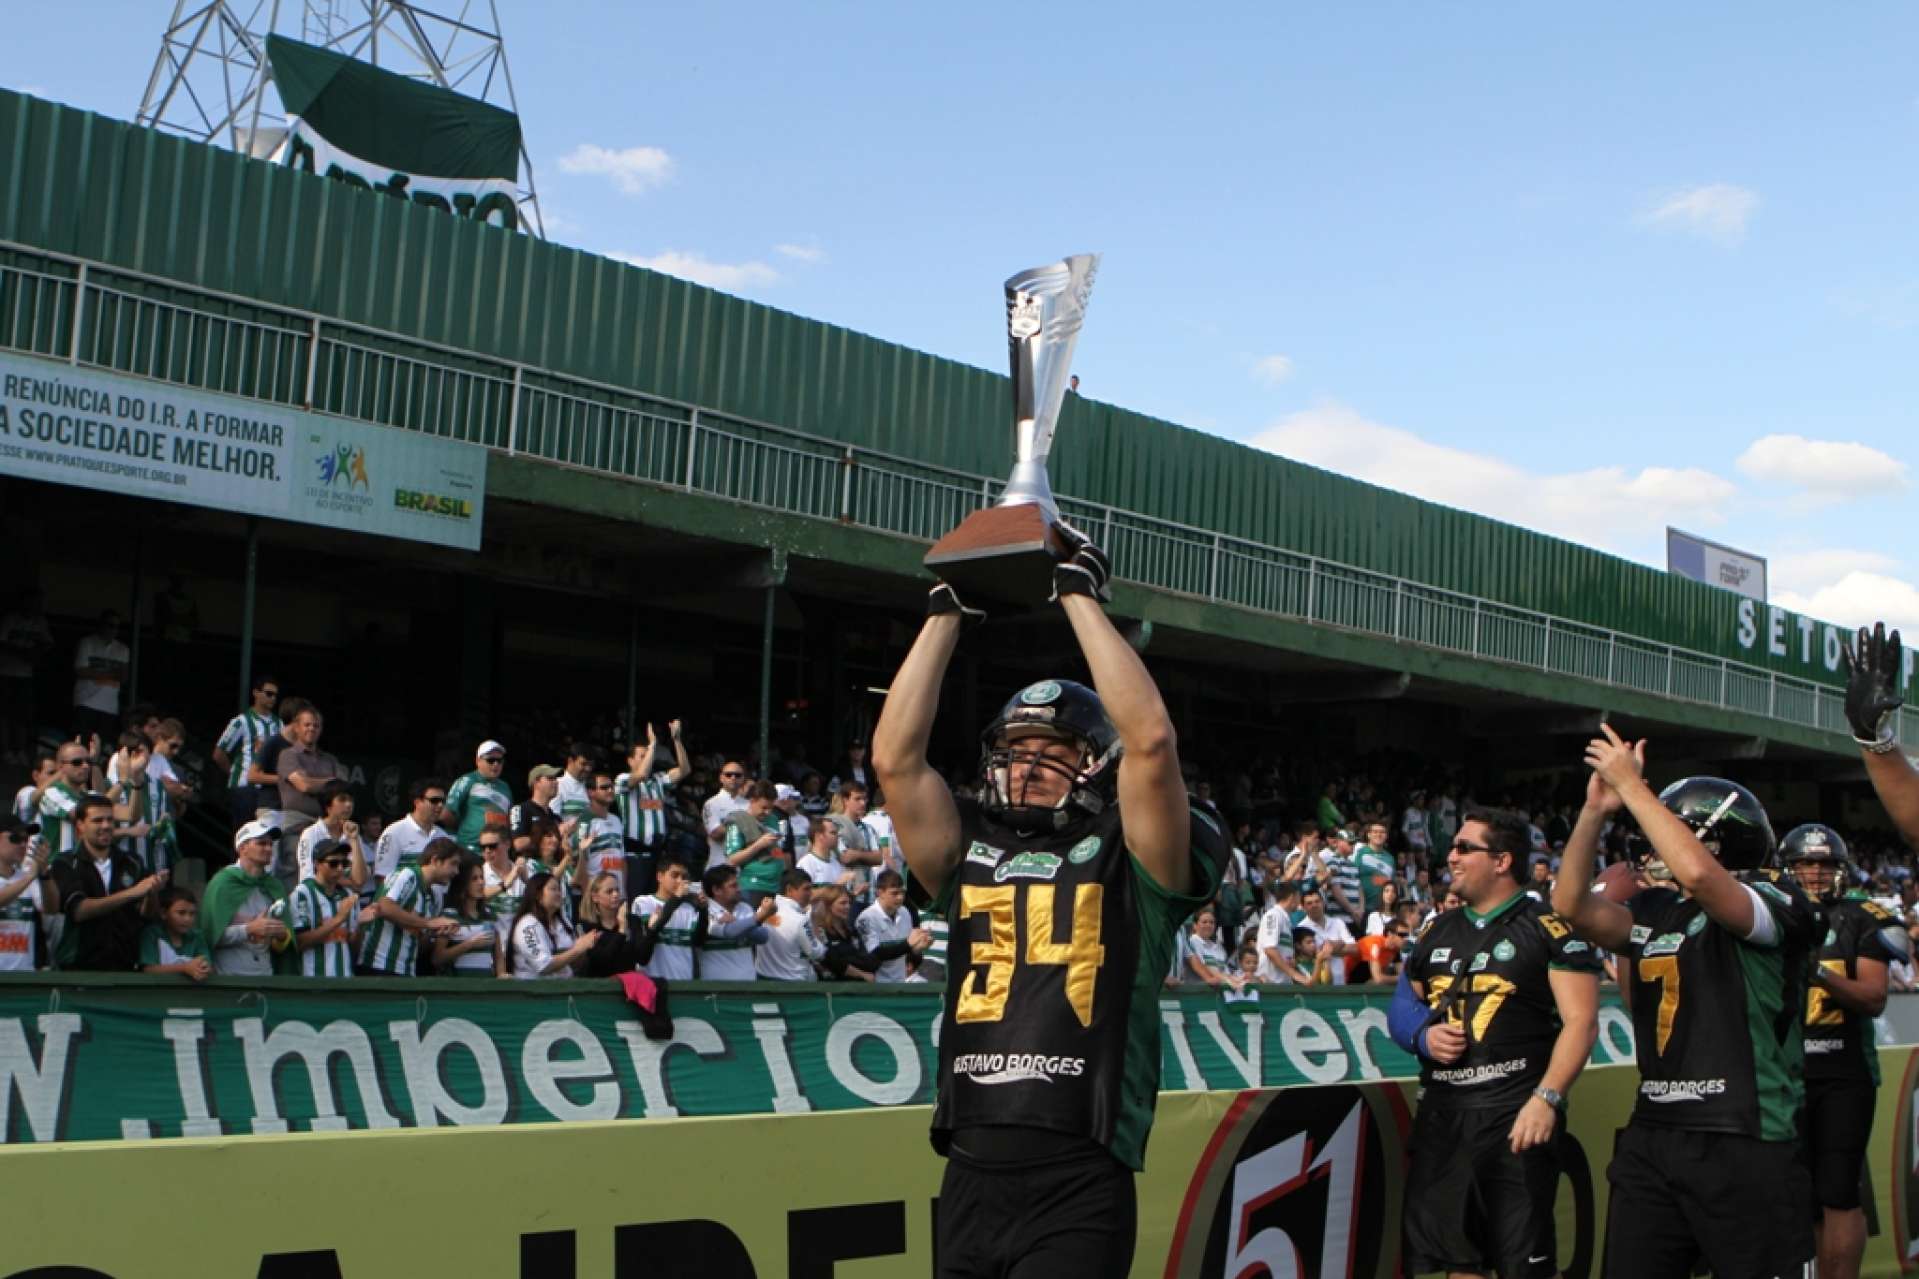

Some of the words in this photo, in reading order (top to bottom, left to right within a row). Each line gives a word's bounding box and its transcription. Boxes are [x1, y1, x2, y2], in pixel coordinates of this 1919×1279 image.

[4, 373, 112, 416] RENÚNCIA
[117, 395, 145, 421] DO
[186, 409, 200, 432] A
[203, 412, 285, 447] FORMAR
[18, 408, 168, 462] SOCIEDADE
[172, 436, 281, 482] MELHOR.
[395, 488, 472, 519] BRASIL
[1738, 599, 1860, 672] SETO
[955, 883, 1105, 1028] 34
[1638, 955, 1680, 1058] 7
[1006, 1053, 1085, 1076] BORGES
[1476, 1057, 1527, 1079] BORGES
[1669, 1079, 1725, 1096] BORGES
